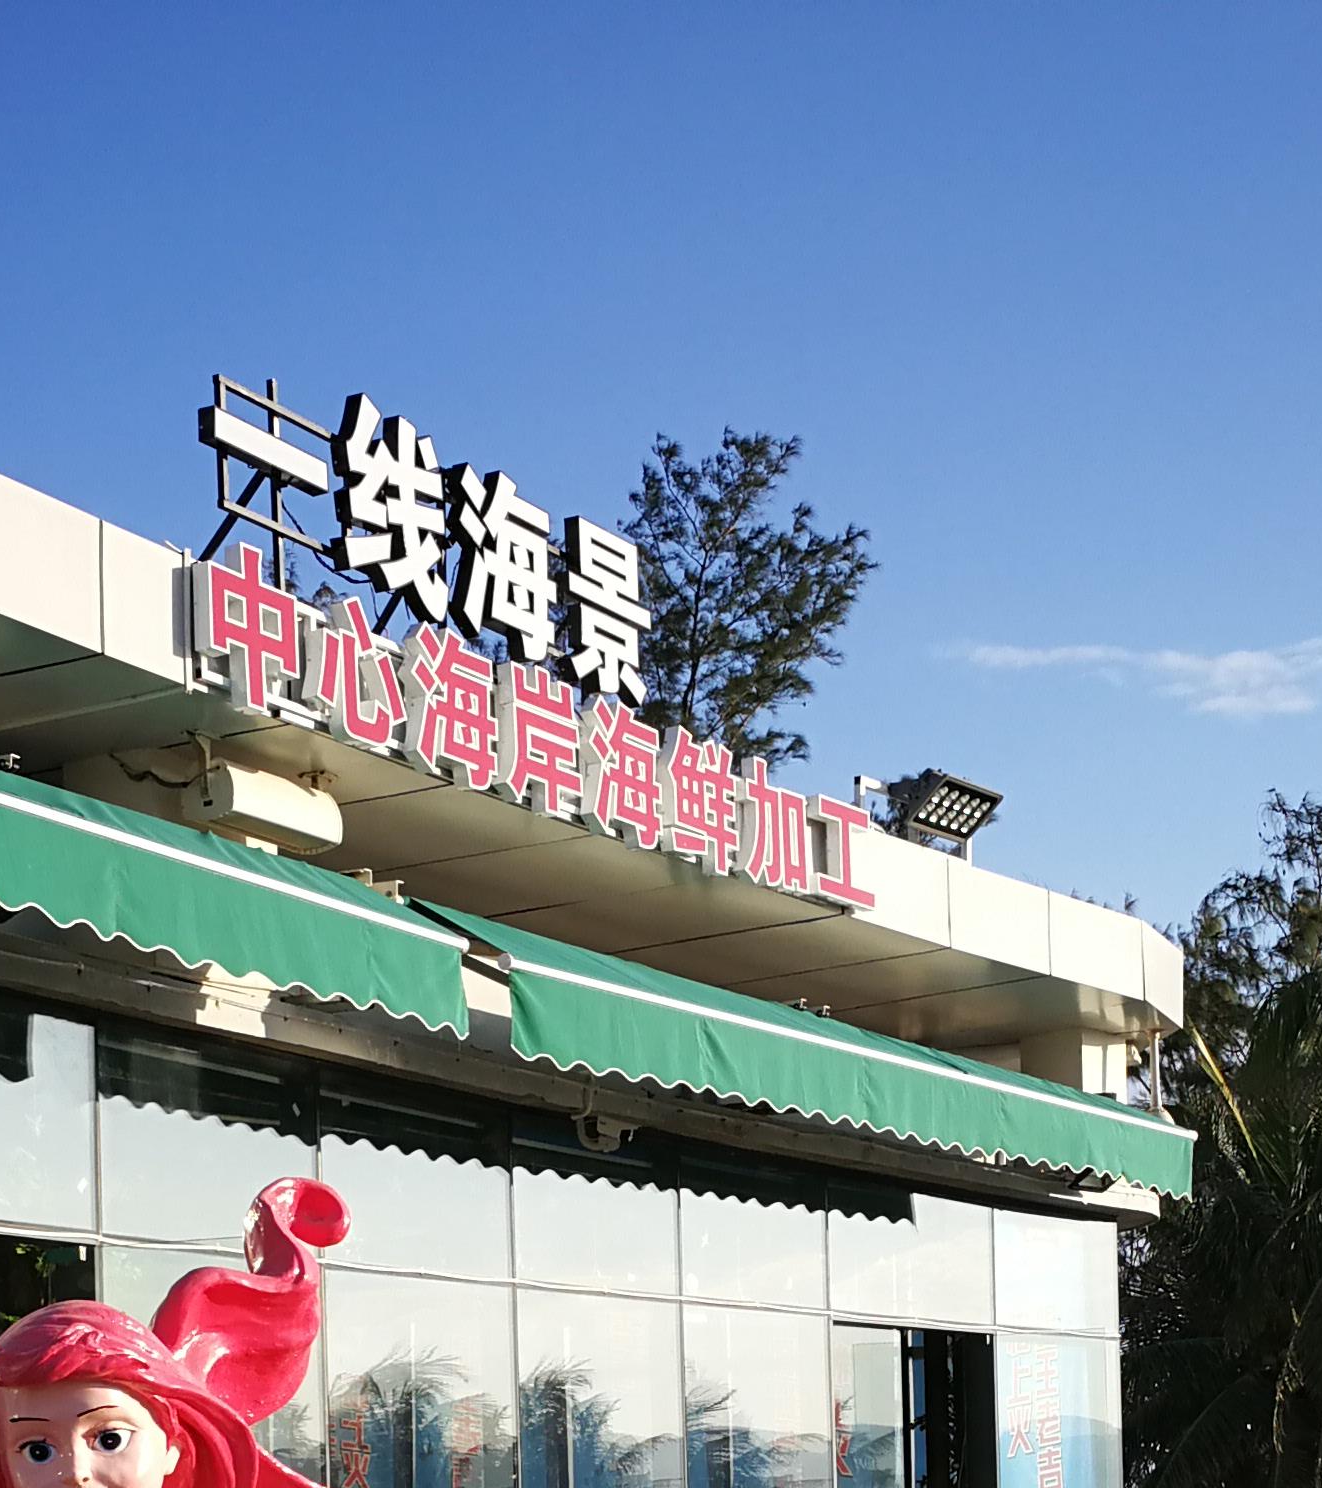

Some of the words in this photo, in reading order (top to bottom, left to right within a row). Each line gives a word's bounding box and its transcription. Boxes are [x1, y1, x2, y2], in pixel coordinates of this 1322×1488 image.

[205, 392, 653, 704] 一线海景
[205, 542, 877, 910] 中心海岸海鲜加工
